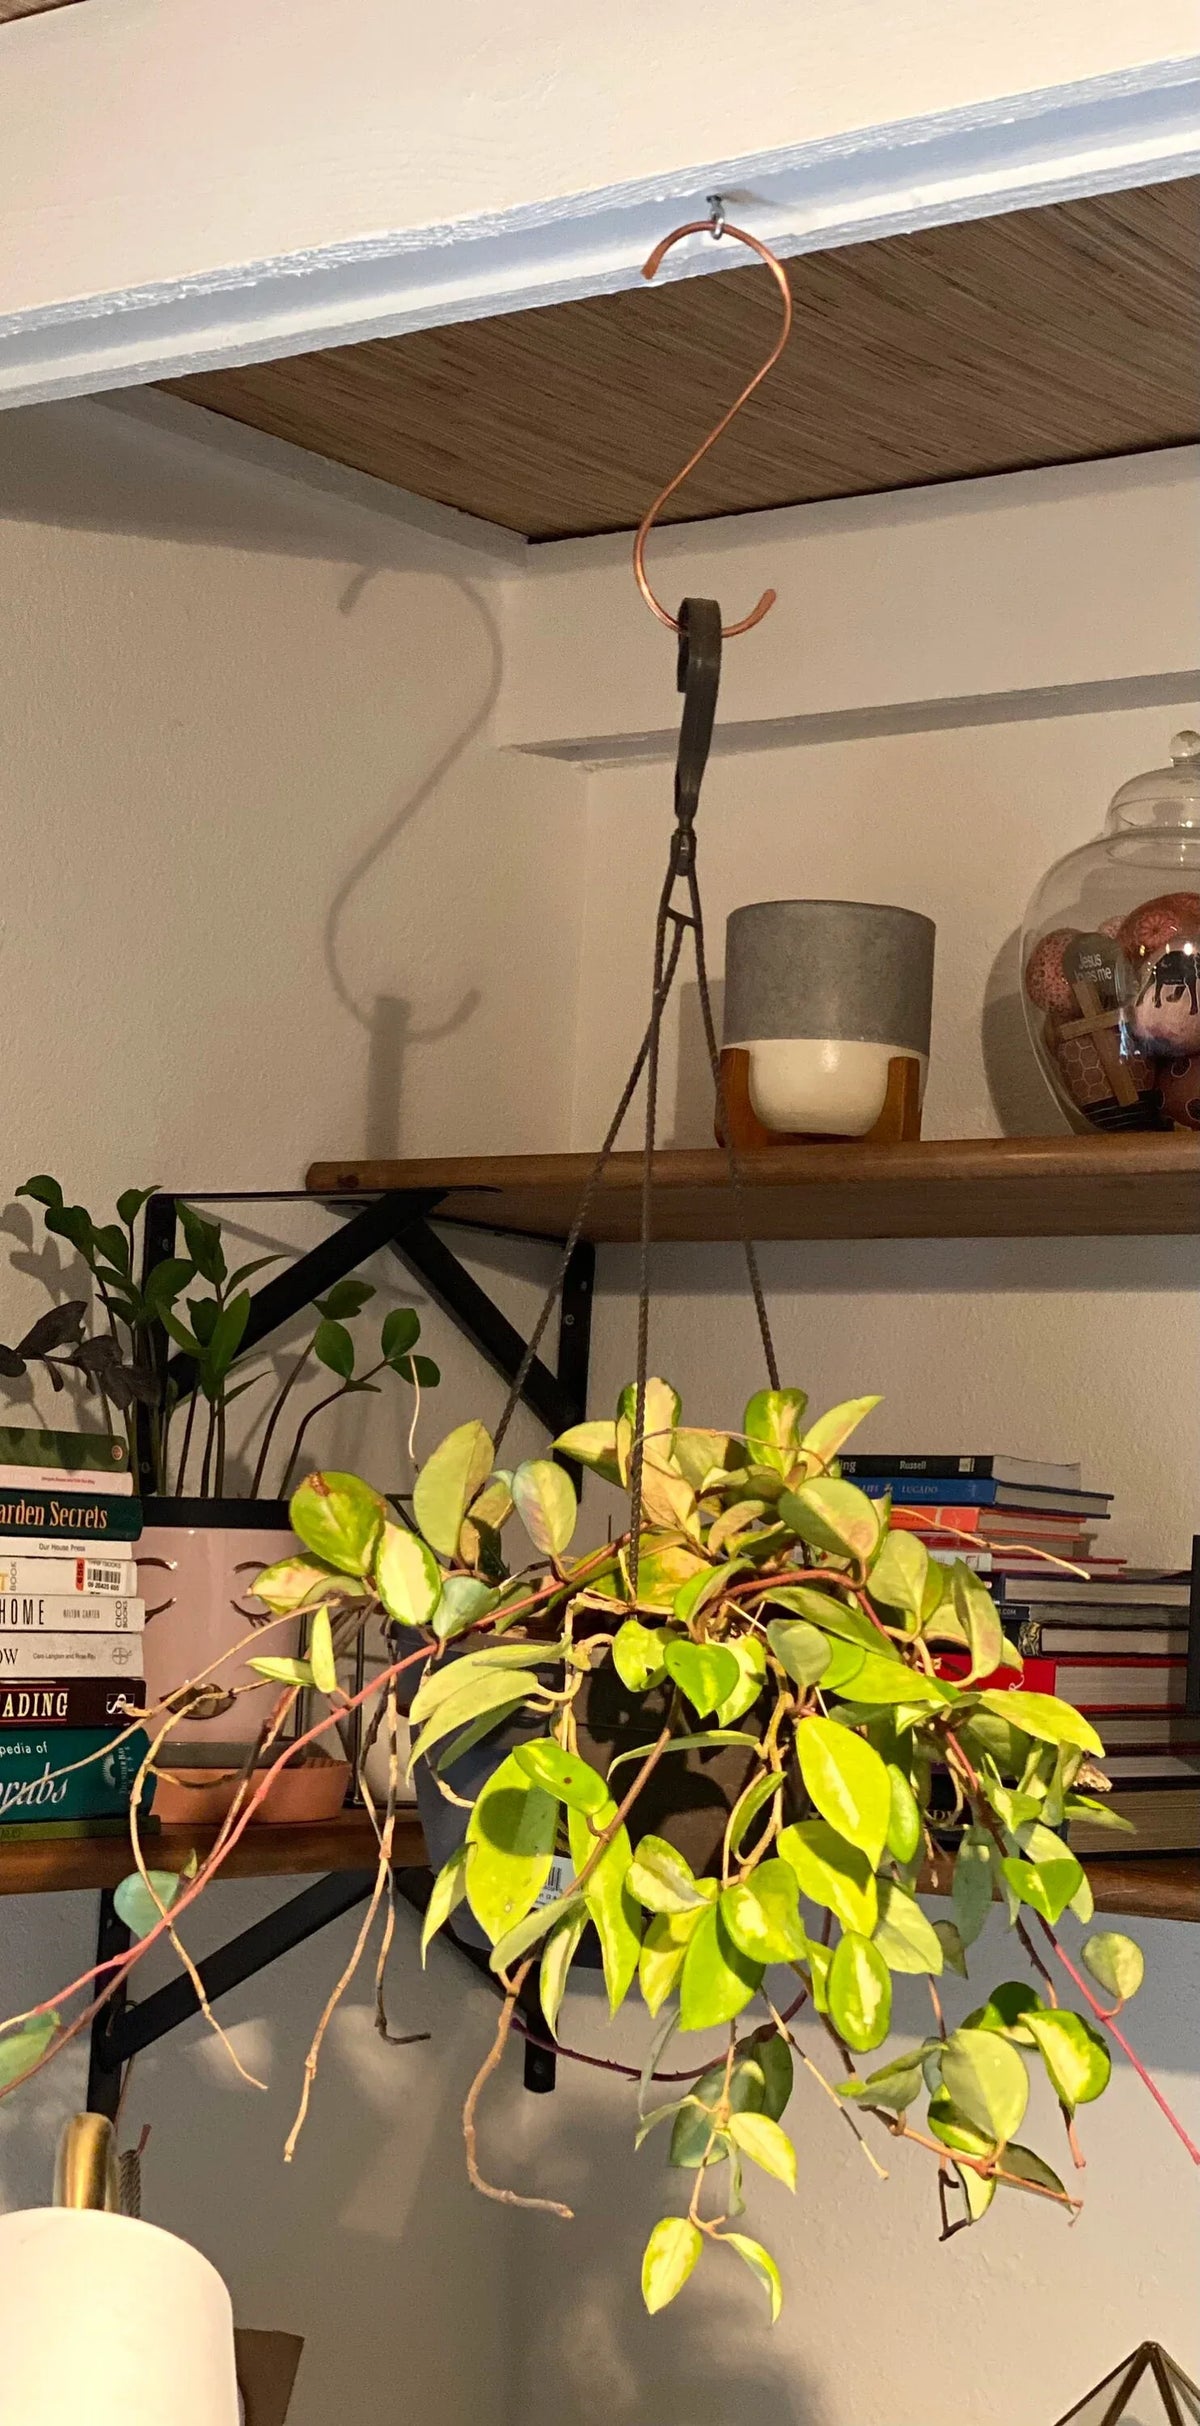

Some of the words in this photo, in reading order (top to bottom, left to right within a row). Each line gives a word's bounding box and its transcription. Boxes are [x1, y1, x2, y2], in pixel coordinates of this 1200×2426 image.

[1078, 951, 1102, 969] Jesus
[1097, 967, 1112, 981] me
[899, 1460, 927, 1470] Russell
[49, 1500, 109, 1529] Secrets
[38, 1543, 50, 1551] Our
[51, 1544, 69, 1552] House
[70, 1544, 86, 1552] Press
[10, 1561, 18, 1592] BOOK
[114, 1600, 122, 1628] CICO
[2, 1692, 69, 1718] ADING
[36, 1741, 48, 1754] of
[0, 1761, 69, 1806] rubs
